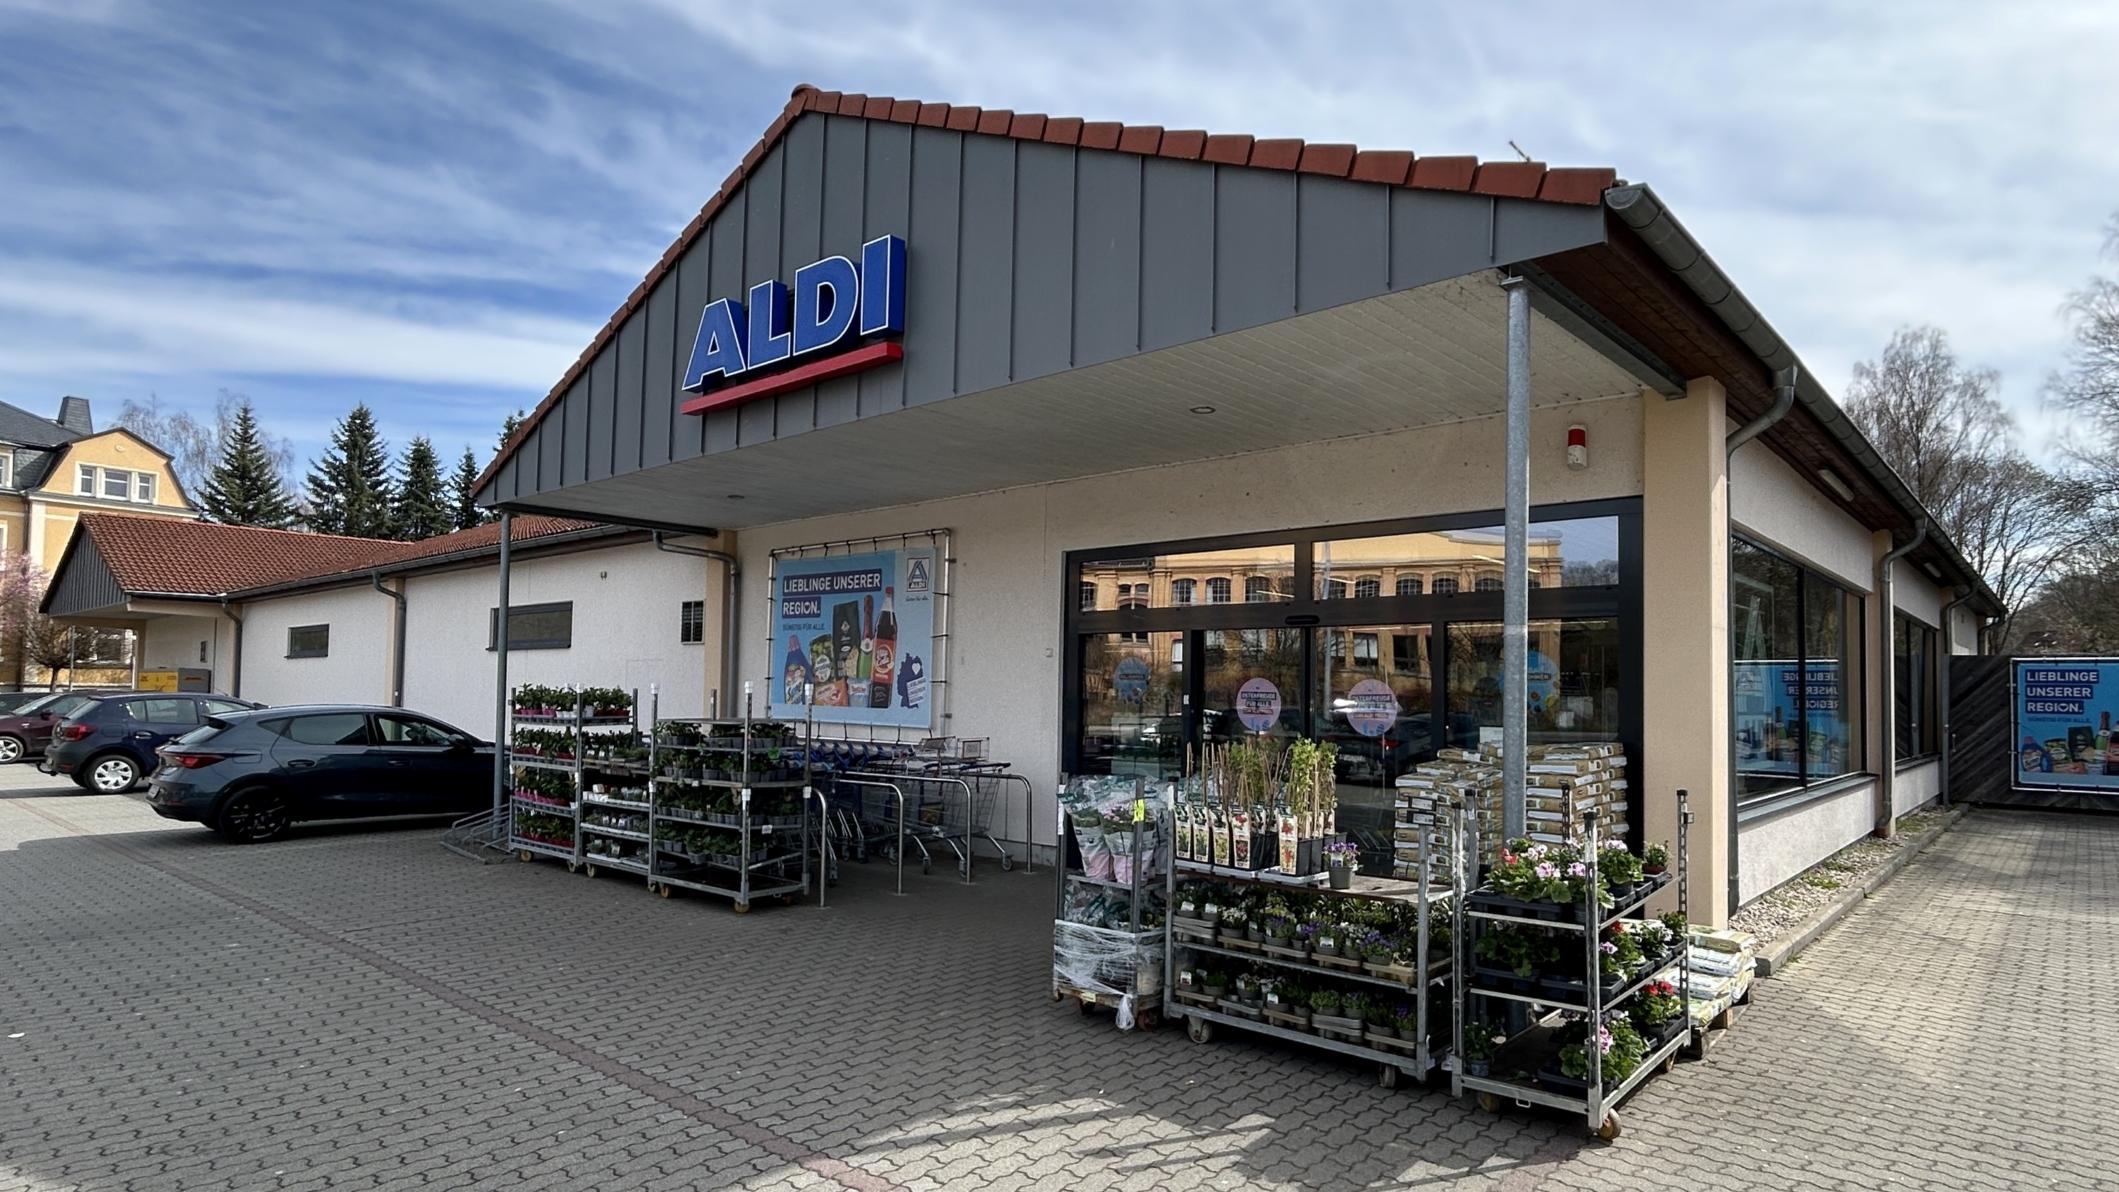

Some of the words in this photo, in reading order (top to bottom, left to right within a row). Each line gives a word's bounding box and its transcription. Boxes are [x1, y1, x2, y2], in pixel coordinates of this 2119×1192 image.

[682, 234, 900, 391] ALDI
[784, 577, 831, 593] LIEBLINGE
[833, 573, 881, 590] UNSERER
[783, 601, 820, 615] REGION.
[2026, 671, 2098, 682] LIEBLINGE
[2026, 687, 2091, 697] UNSERER
[2026, 702, 2083, 712] REGION.
